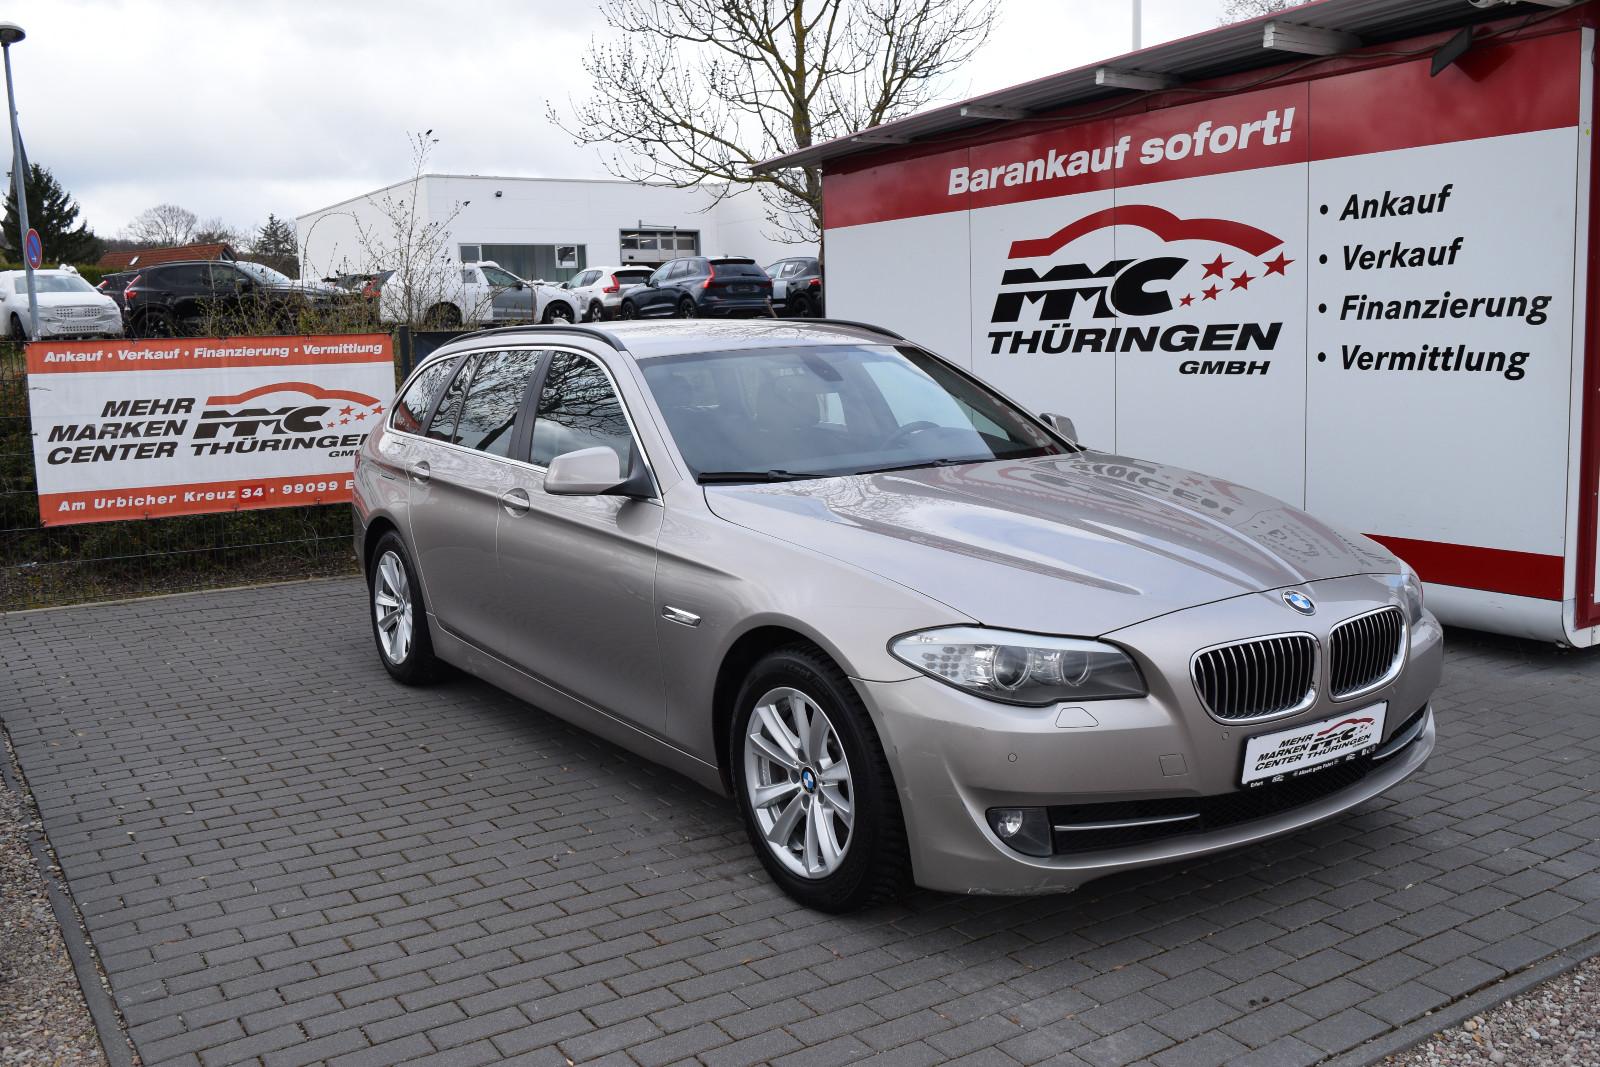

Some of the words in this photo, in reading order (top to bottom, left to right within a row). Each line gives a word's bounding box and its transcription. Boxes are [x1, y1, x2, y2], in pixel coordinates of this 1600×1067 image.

[948, 136, 1131, 195] Barankauf
[1139, 107, 1296, 165] sofort!
[1339, 183, 1453, 221] Ankauf
[1343, 237, 1464, 270] Verkauf
[1340, 291, 1552, 325] Finanzierung
[44, 351, 103, 363] Ankauf
[117, 348, 180, 361] Verkauf
[194, 346, 289, 360] Finanzierung
[303, 343, 383, 357] Vermittlung
[988, 322, 1283, 354] THÜRINGEN
[1179, 361, 1270, 375] GMBH
[1341, 344, 1530, 380] Vermittlung
[101, 397, 196, 418] MEHR
[48, 419, 188, 442] MARKEN
[47, 442, 178, 465] CENTER
[58, 499, 86, 511] Am
[94, 493, 176, 509] Urbicher
[184, 489, 236, 502] Kreuz
[241, 486, 264, 498] 34
[282, 481, 338, 494] 99099
[1255, 753, 1303, 771] CENTER
[1308, 733, 1371, 759] THÜRINGEN
[1257, 743, 1309, 762] MARKEN
[1279, 733, 1314, 749] MEHR
